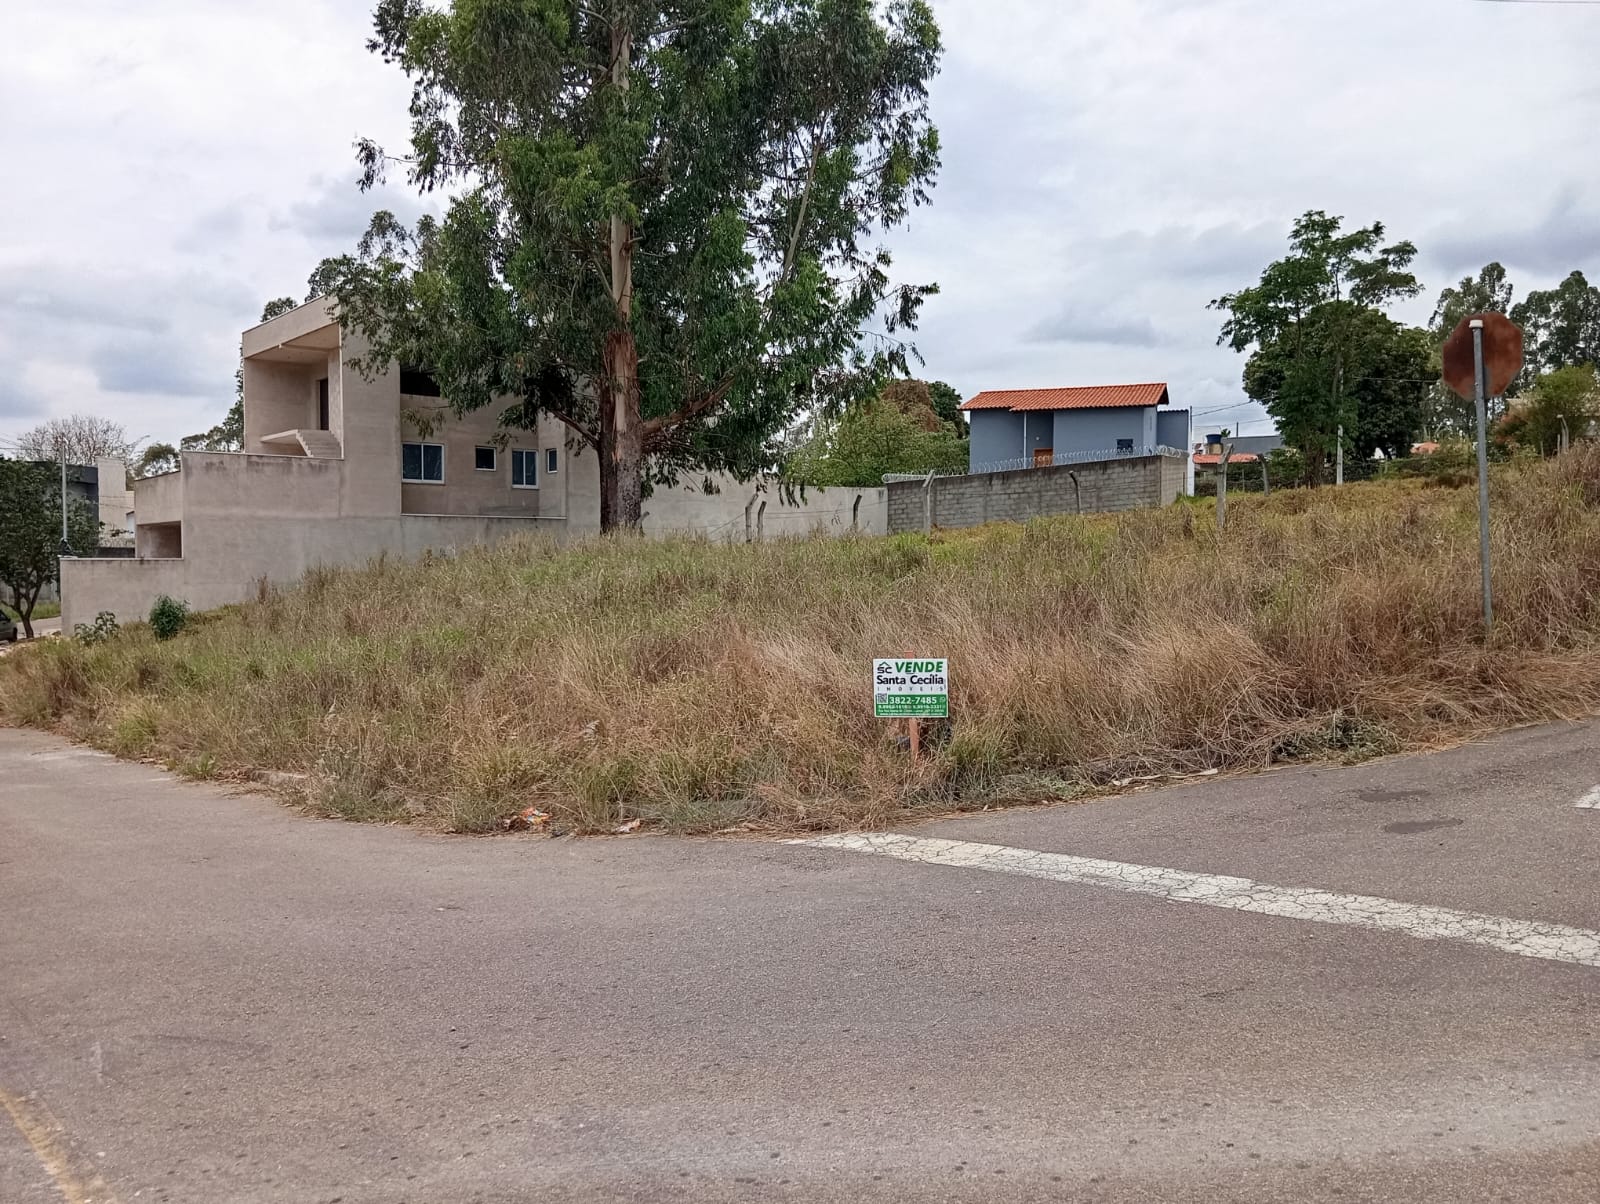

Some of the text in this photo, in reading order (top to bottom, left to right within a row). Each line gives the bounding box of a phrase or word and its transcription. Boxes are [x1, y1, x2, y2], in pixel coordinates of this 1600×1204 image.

[895, 661, 944, 673] VENDE
[876, 675, 906, 685] Santa
[889, 696, 937, 705] 3822-7485
